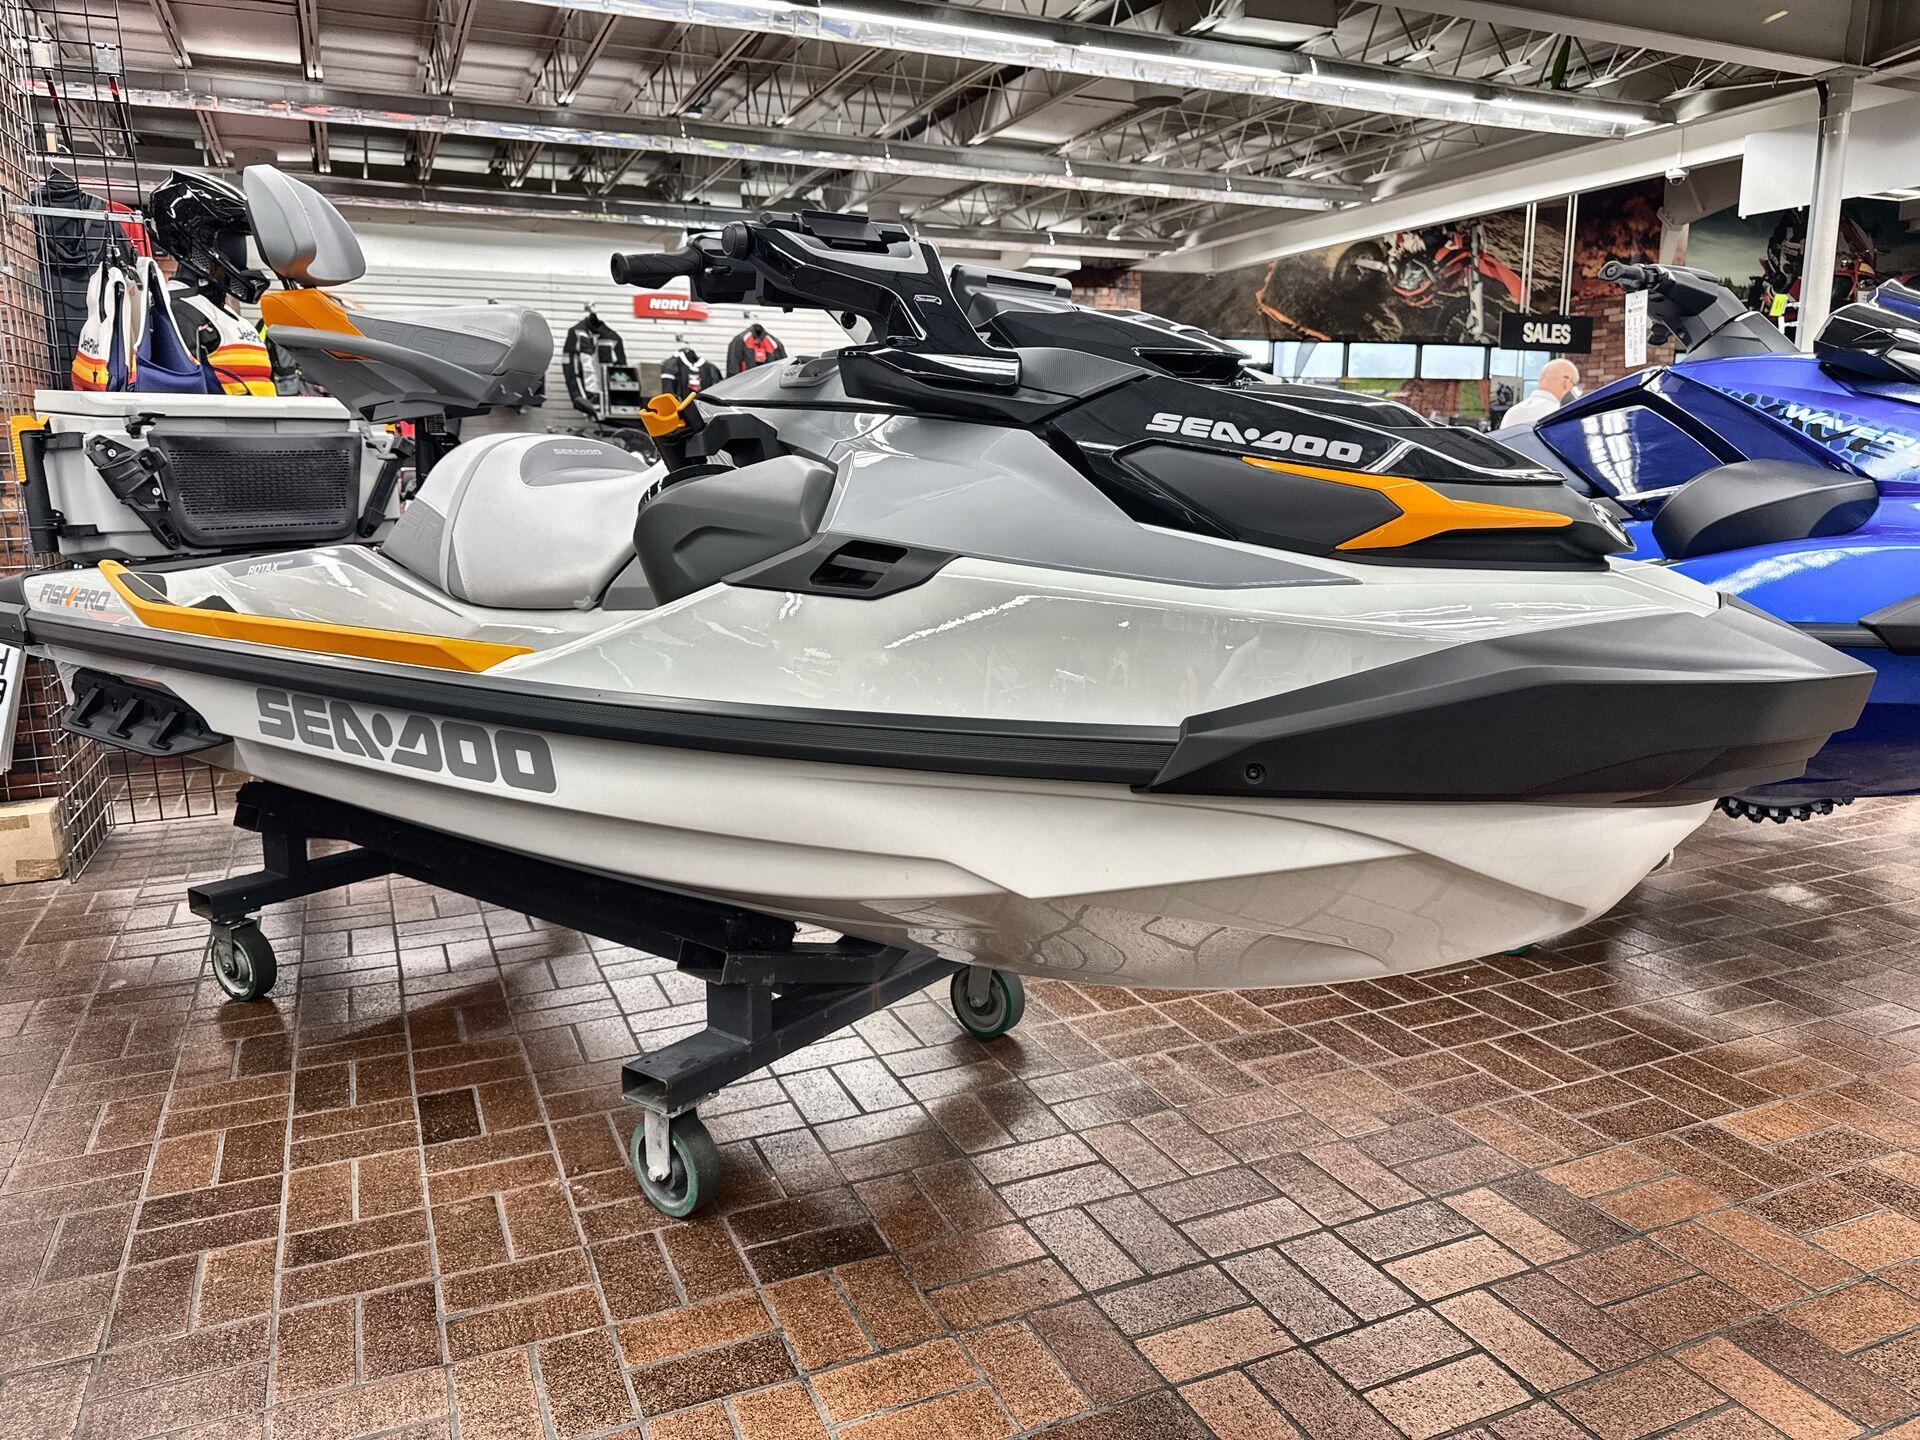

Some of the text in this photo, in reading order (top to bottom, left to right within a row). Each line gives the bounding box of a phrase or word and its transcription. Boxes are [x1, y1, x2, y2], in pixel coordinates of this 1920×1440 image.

[649, 298, 690, 311] NORU
[1522, 322, 1571, 345] SALES
[247, 561, 280, 577] ROTAX
